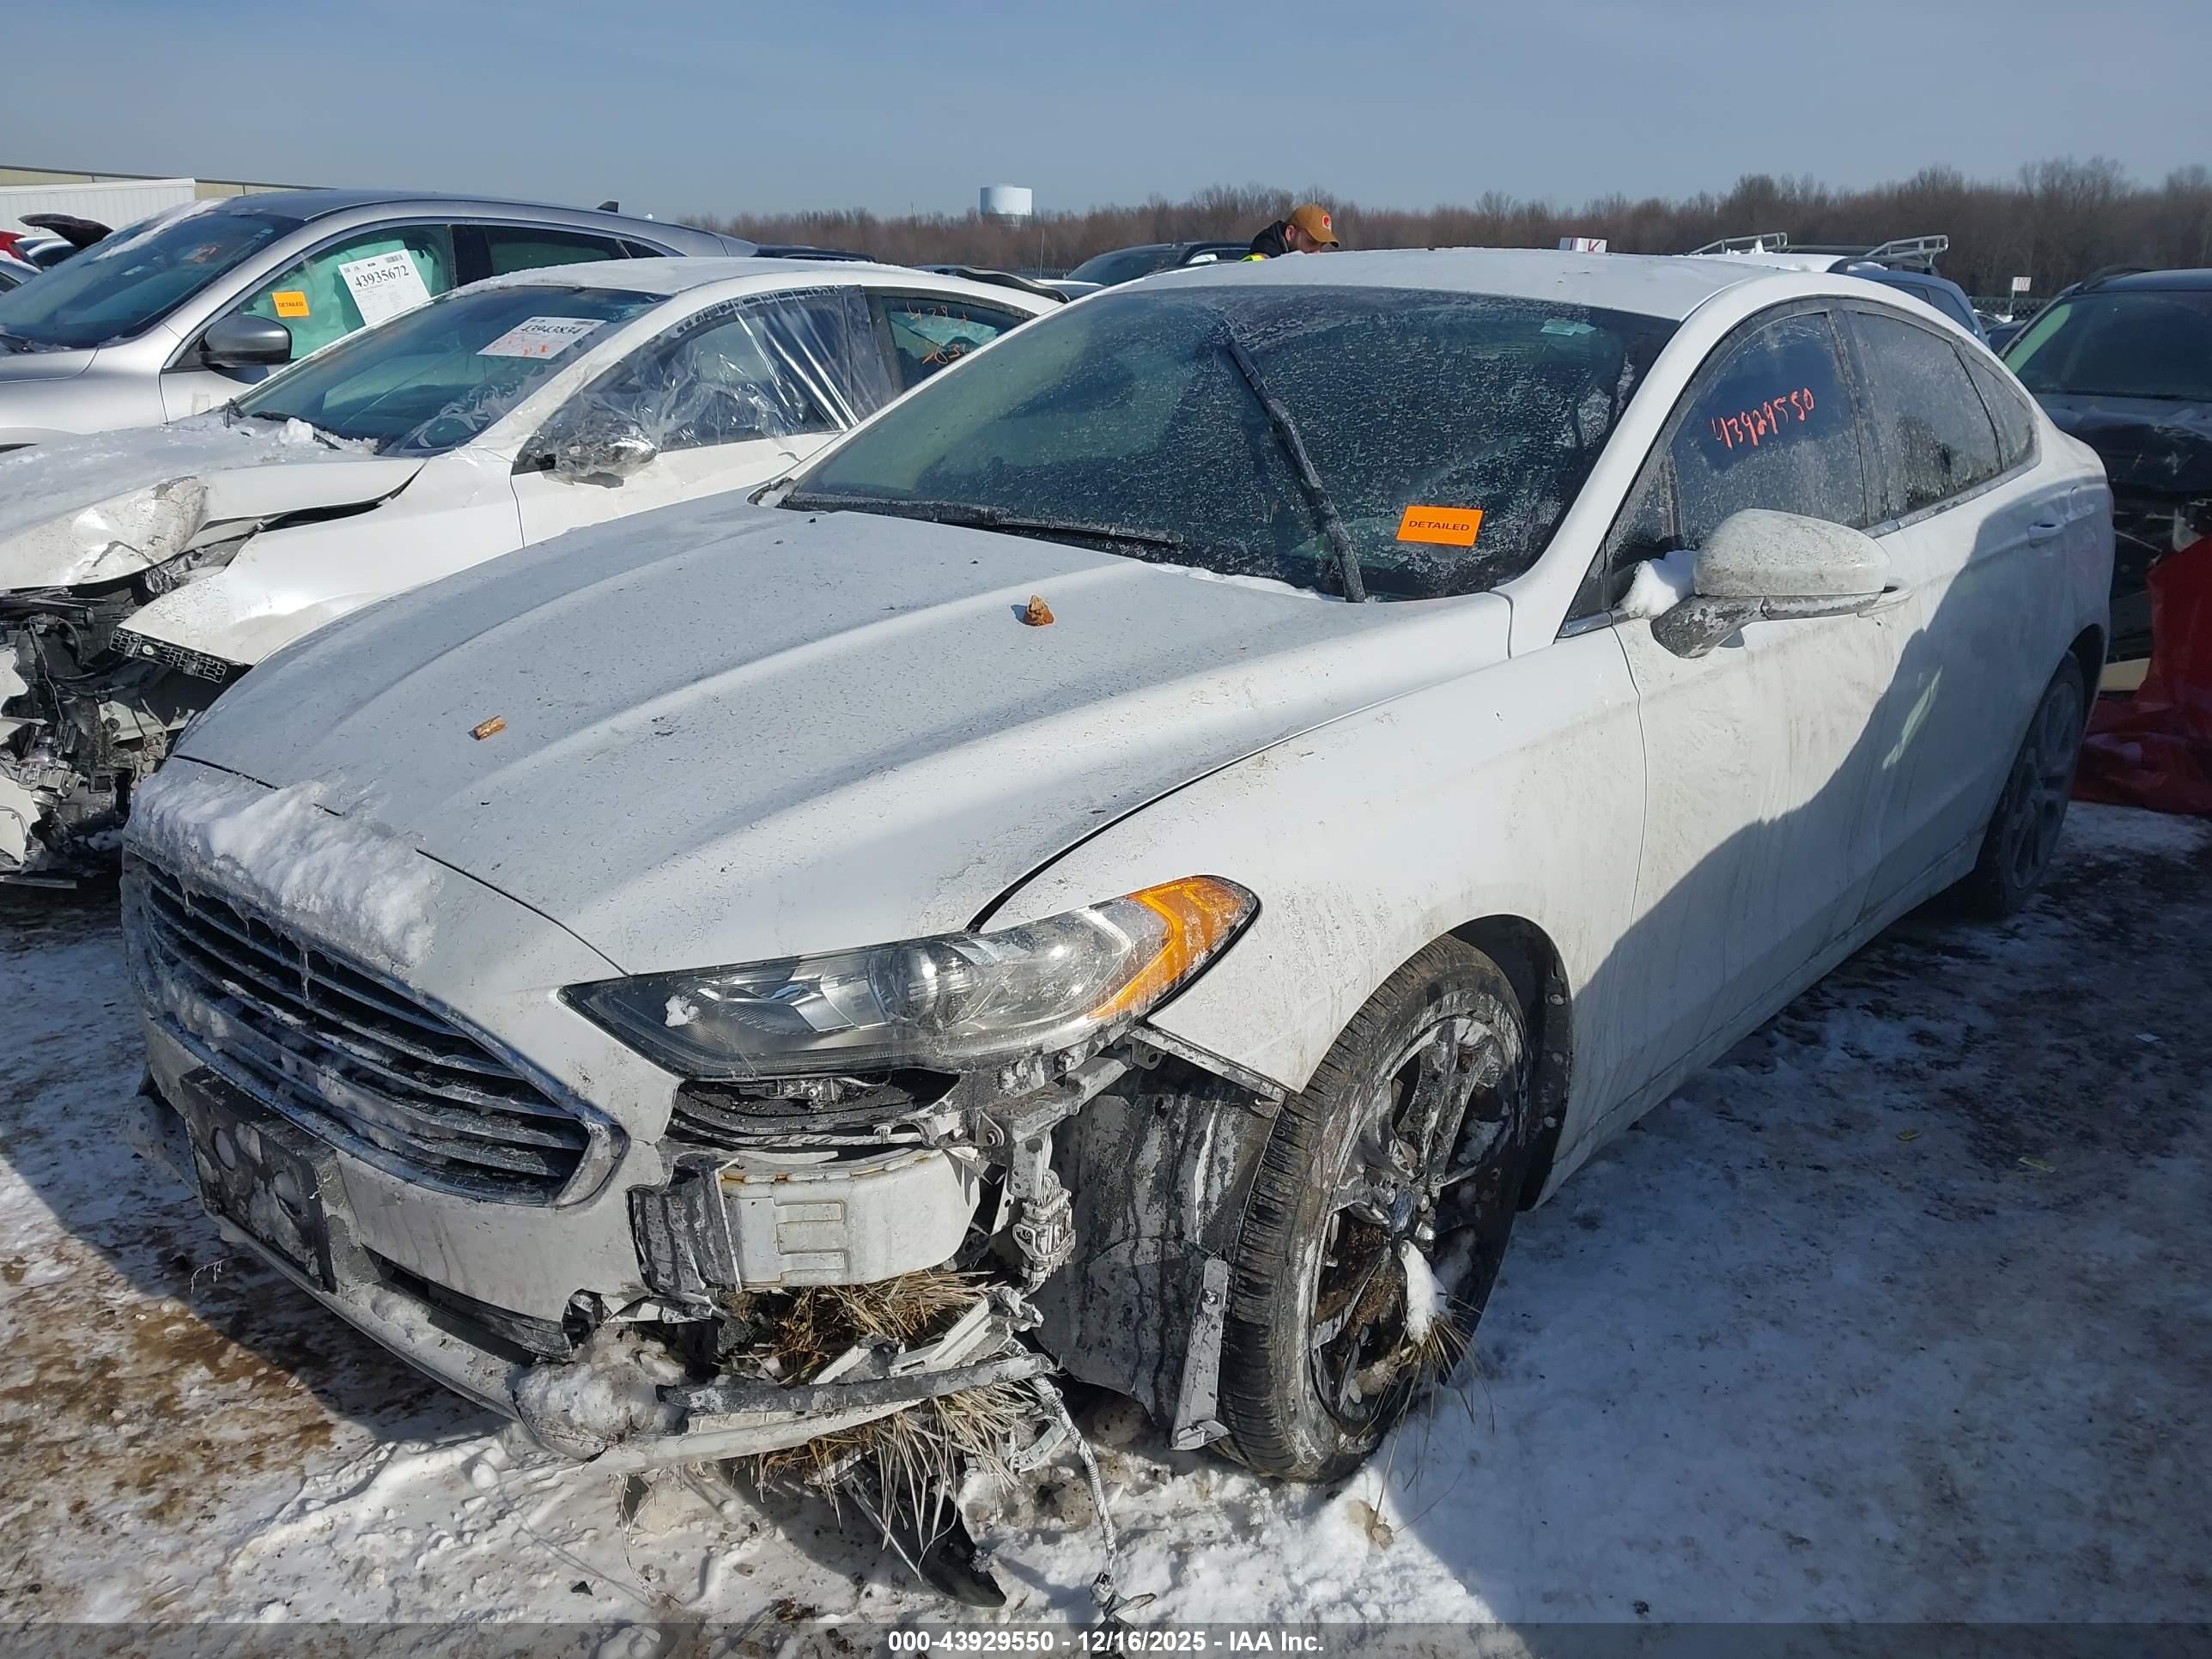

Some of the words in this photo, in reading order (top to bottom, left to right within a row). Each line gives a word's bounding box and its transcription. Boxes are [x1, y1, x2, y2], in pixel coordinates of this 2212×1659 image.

[355, 264, 410, 288] 43935672
[1711, 387, 1814, 450] 43929550
[1408, 520, 1470, 532] DETAILED
